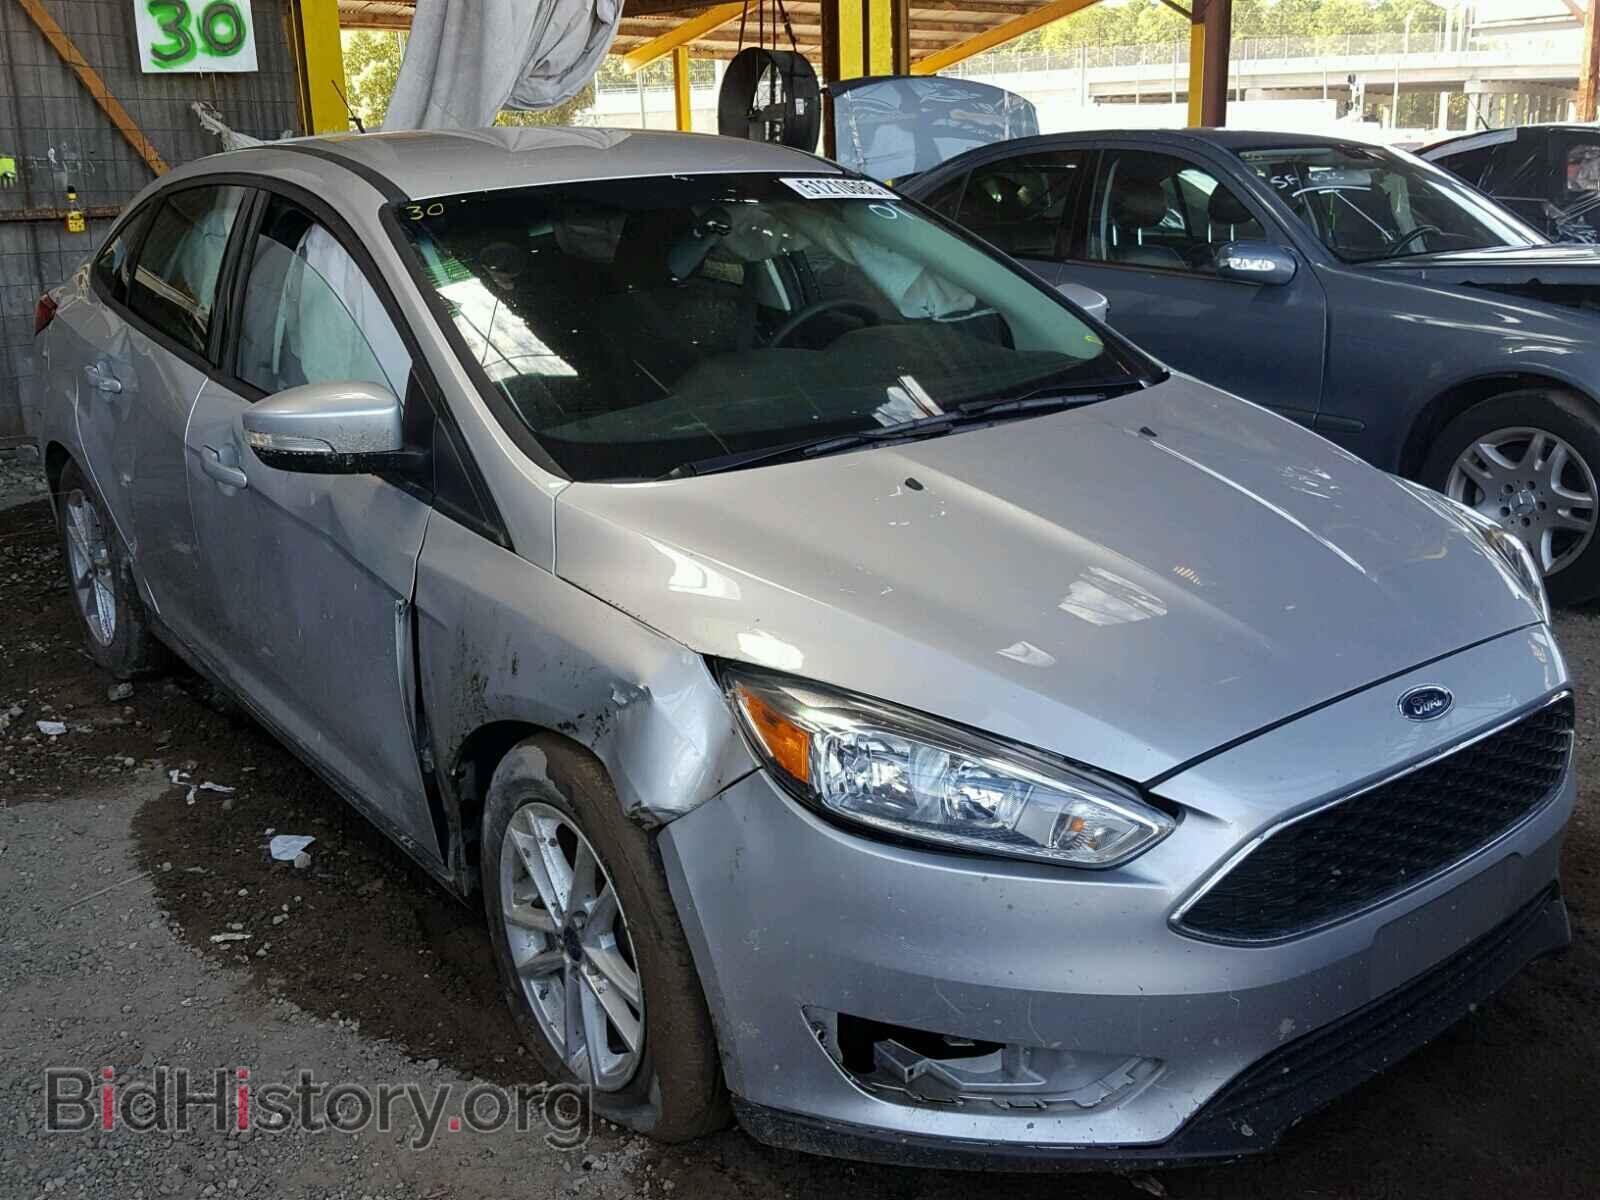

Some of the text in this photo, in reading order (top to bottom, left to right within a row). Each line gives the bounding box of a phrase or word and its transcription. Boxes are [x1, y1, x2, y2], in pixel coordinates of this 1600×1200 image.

[147, 0, 246, 68] 30
[405, 203, 444, 220] 30
[1409, 693, 1443, 714] Ford
